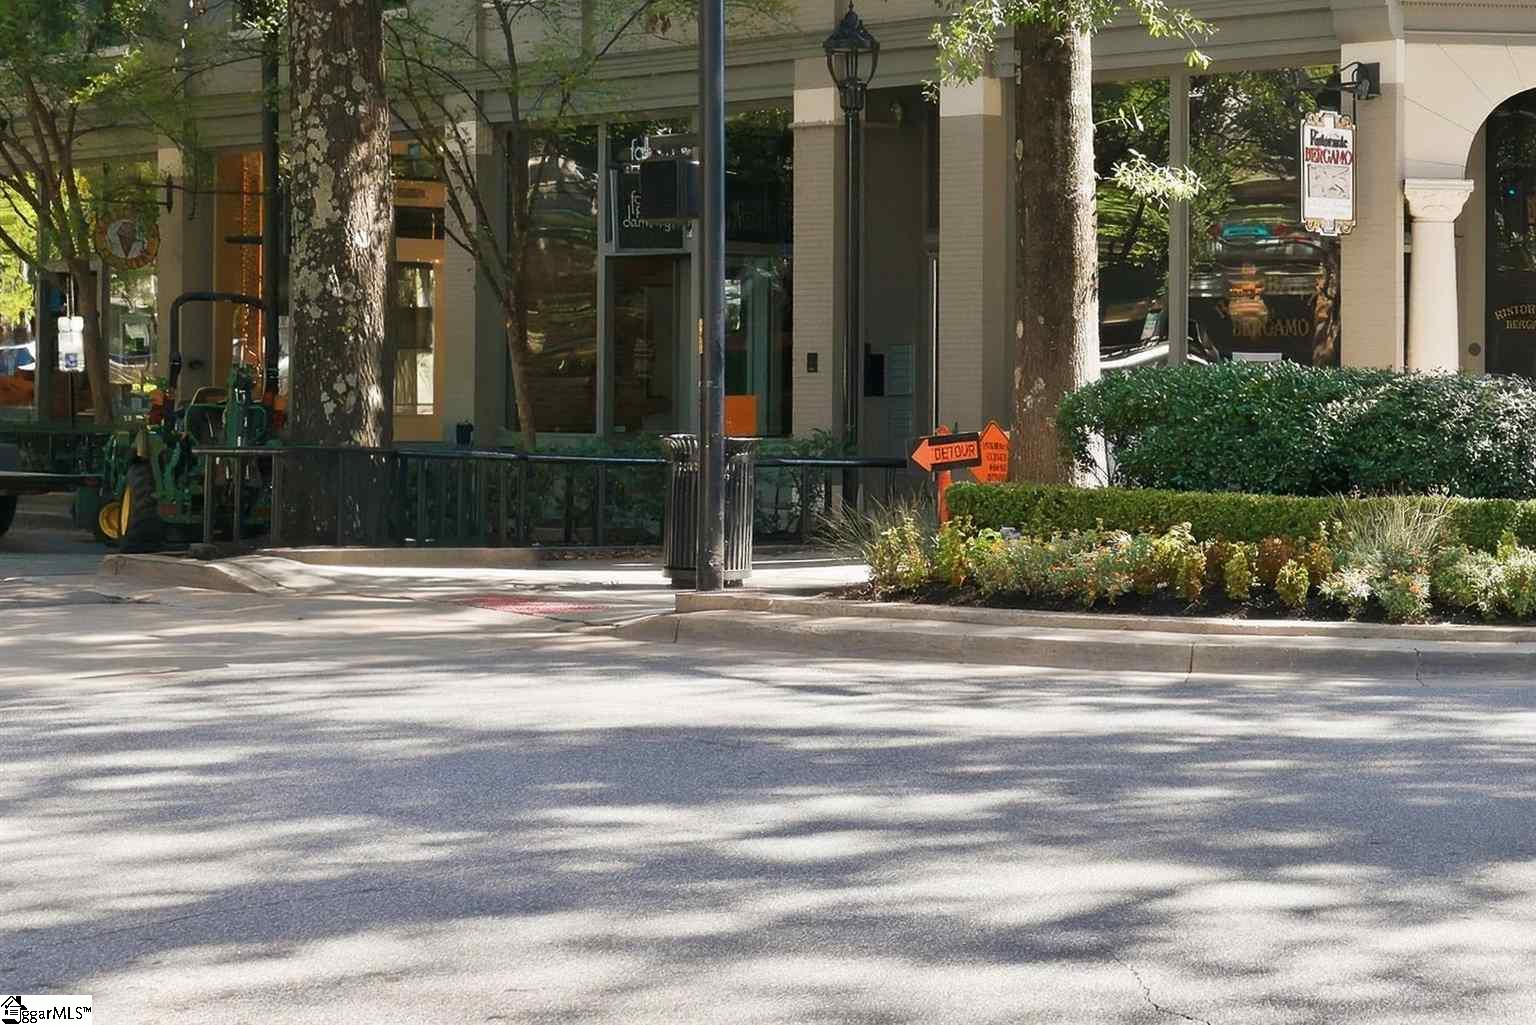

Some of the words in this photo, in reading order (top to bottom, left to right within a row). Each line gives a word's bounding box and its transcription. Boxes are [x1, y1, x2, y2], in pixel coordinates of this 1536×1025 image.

[1305, 148, 1353, 166] BERGAMO
[1231, 319, 1309, 336] BERGAMO
[934, 444, 977, 461] DETOUR
